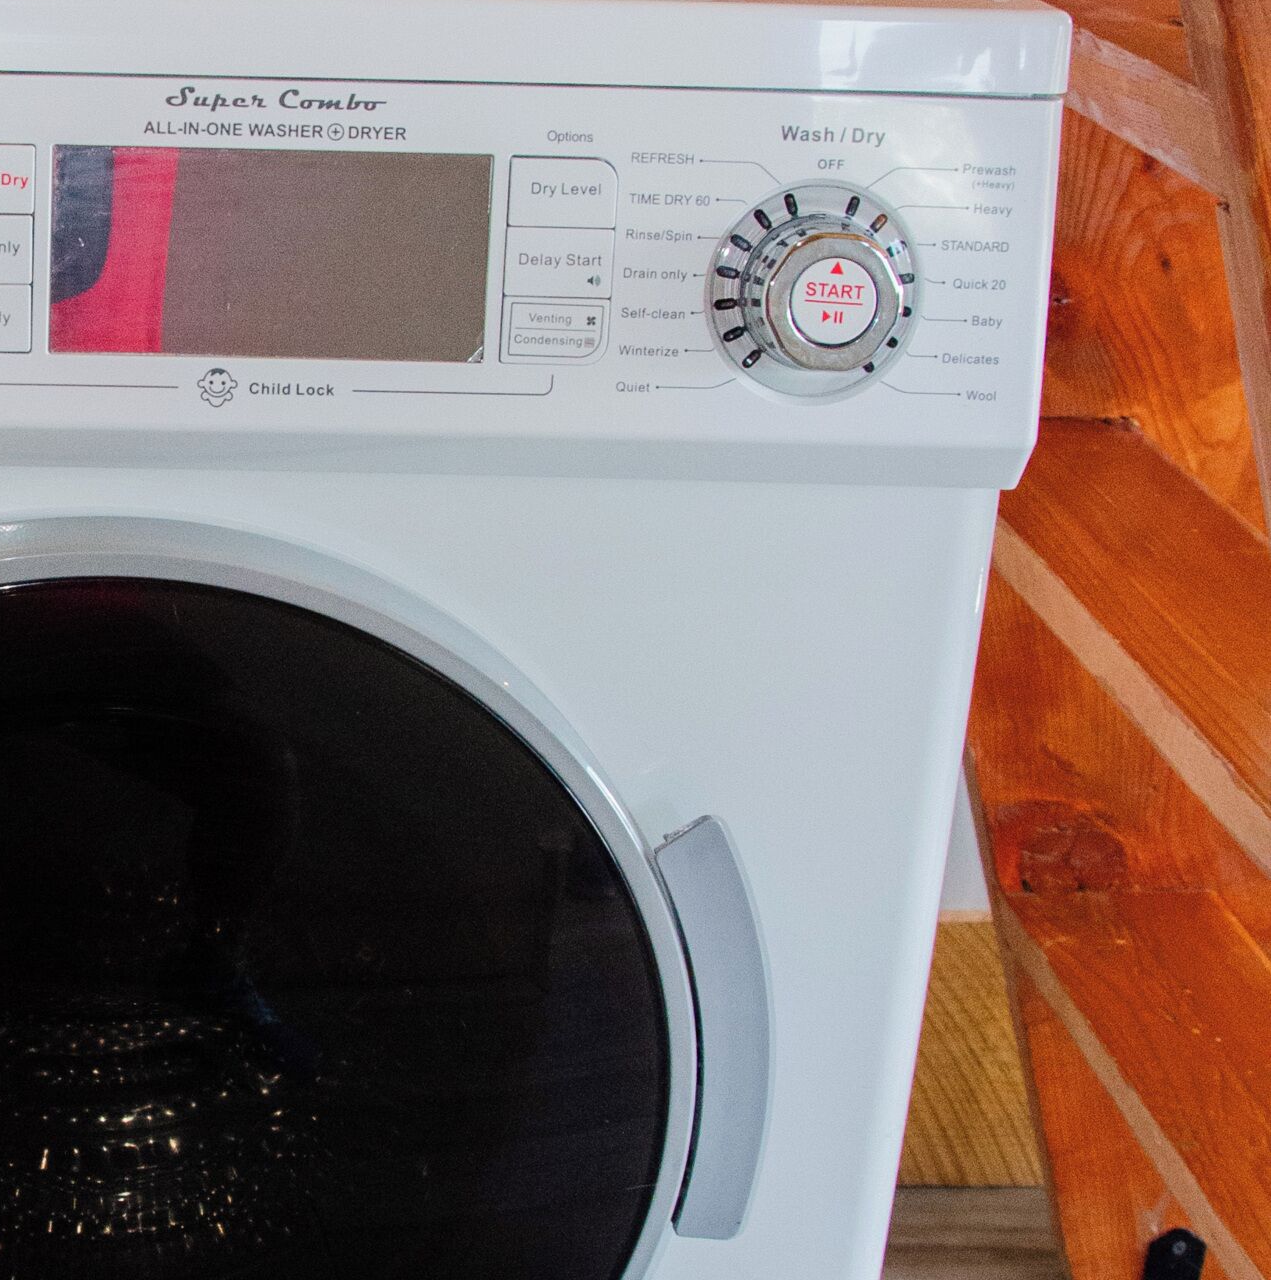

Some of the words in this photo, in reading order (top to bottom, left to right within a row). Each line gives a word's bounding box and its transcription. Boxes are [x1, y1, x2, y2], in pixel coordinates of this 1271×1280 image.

[165, 86, 267, 113] Super
[278, 88, 387, 112] Combo
[143, 120, 243, 137] ALL-IN-ONE
[248, 123, 324, 139] WASHER
[347, 125, 407, 141] DRYER
[546, 129, 594, 145] Options
[781, 125, 835, 143] Wash
[851, 127, 886, 149] Dry
[630, 151, 695, 165] REFRESH
[816, 158, 845, 171] OFF
[962, 162, 1017, 177] Prewash
[530, 181, 557, 199] Dry
[560, 182, 602, 196] Level
[629, 192, 660, 206] TIME
[663, 193, 693, 206] DRY
[694, 194, 711, 207] 60
[973, 203, 1013, 218] Heavy
[625, 228, 693, 244] Rinse/Spin
[940, 239, 1010, 254] STANDARD
[517, 252, 561, 269] Delay
[565, 252, 603, 267] Start
[622, 266, 657, 280] Drain
[660, 269, 688, 283] only
[804, 282, 864, 300] START
[952, 277, 987, 290] Quick
[988, 278, 1007, 292] 20
[528, 312, 573, 328] Venting
[620, 306, 686, 320] Self-clean
[971, 314, 1003, 330] Baby
[513, 333, 583, 350] Condensing
[618, 344, 680, 358] Winterize
[941, 352, 1000, 366] Delicates
[248, 381, 292, 396] Child
[295, 383, 335, 397] Lock
[615, 380, 651, 396] Quiet
[965, 389, 997, 402] Wool
